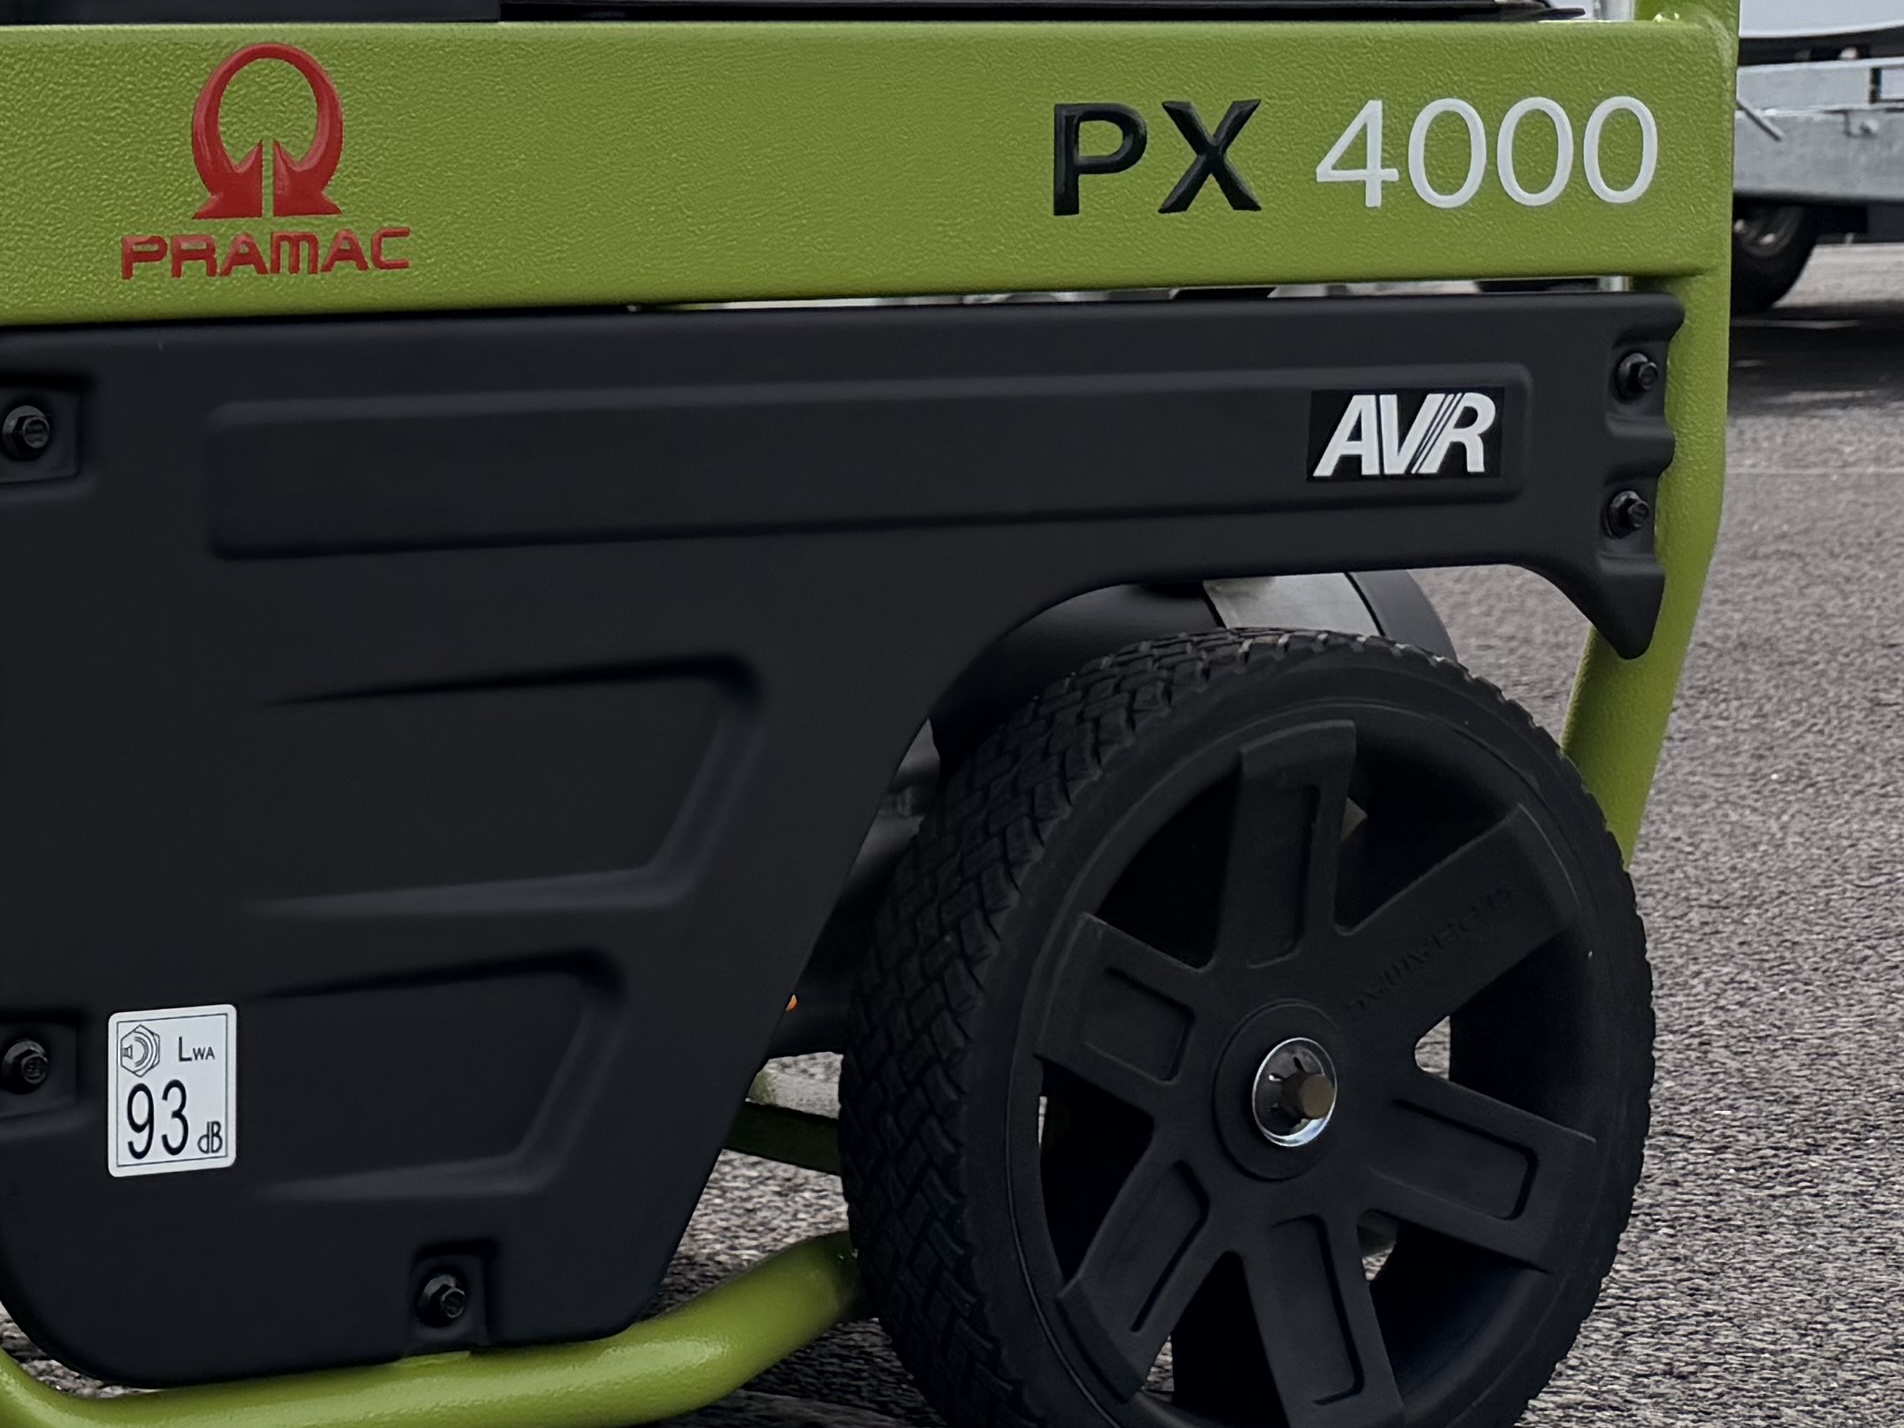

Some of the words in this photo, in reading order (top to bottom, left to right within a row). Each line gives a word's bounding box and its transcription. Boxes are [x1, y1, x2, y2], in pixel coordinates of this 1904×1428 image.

[1053, 99, 1262, 216] PX
[1316, 96, 1658, 208] 4000
[122, 227, 410, 280] PRAMAC
[1312, 392, 1496, 477] AVR
[126, 1079, 189, 1160] 93
[197, 1120, 223, 1154] dB
